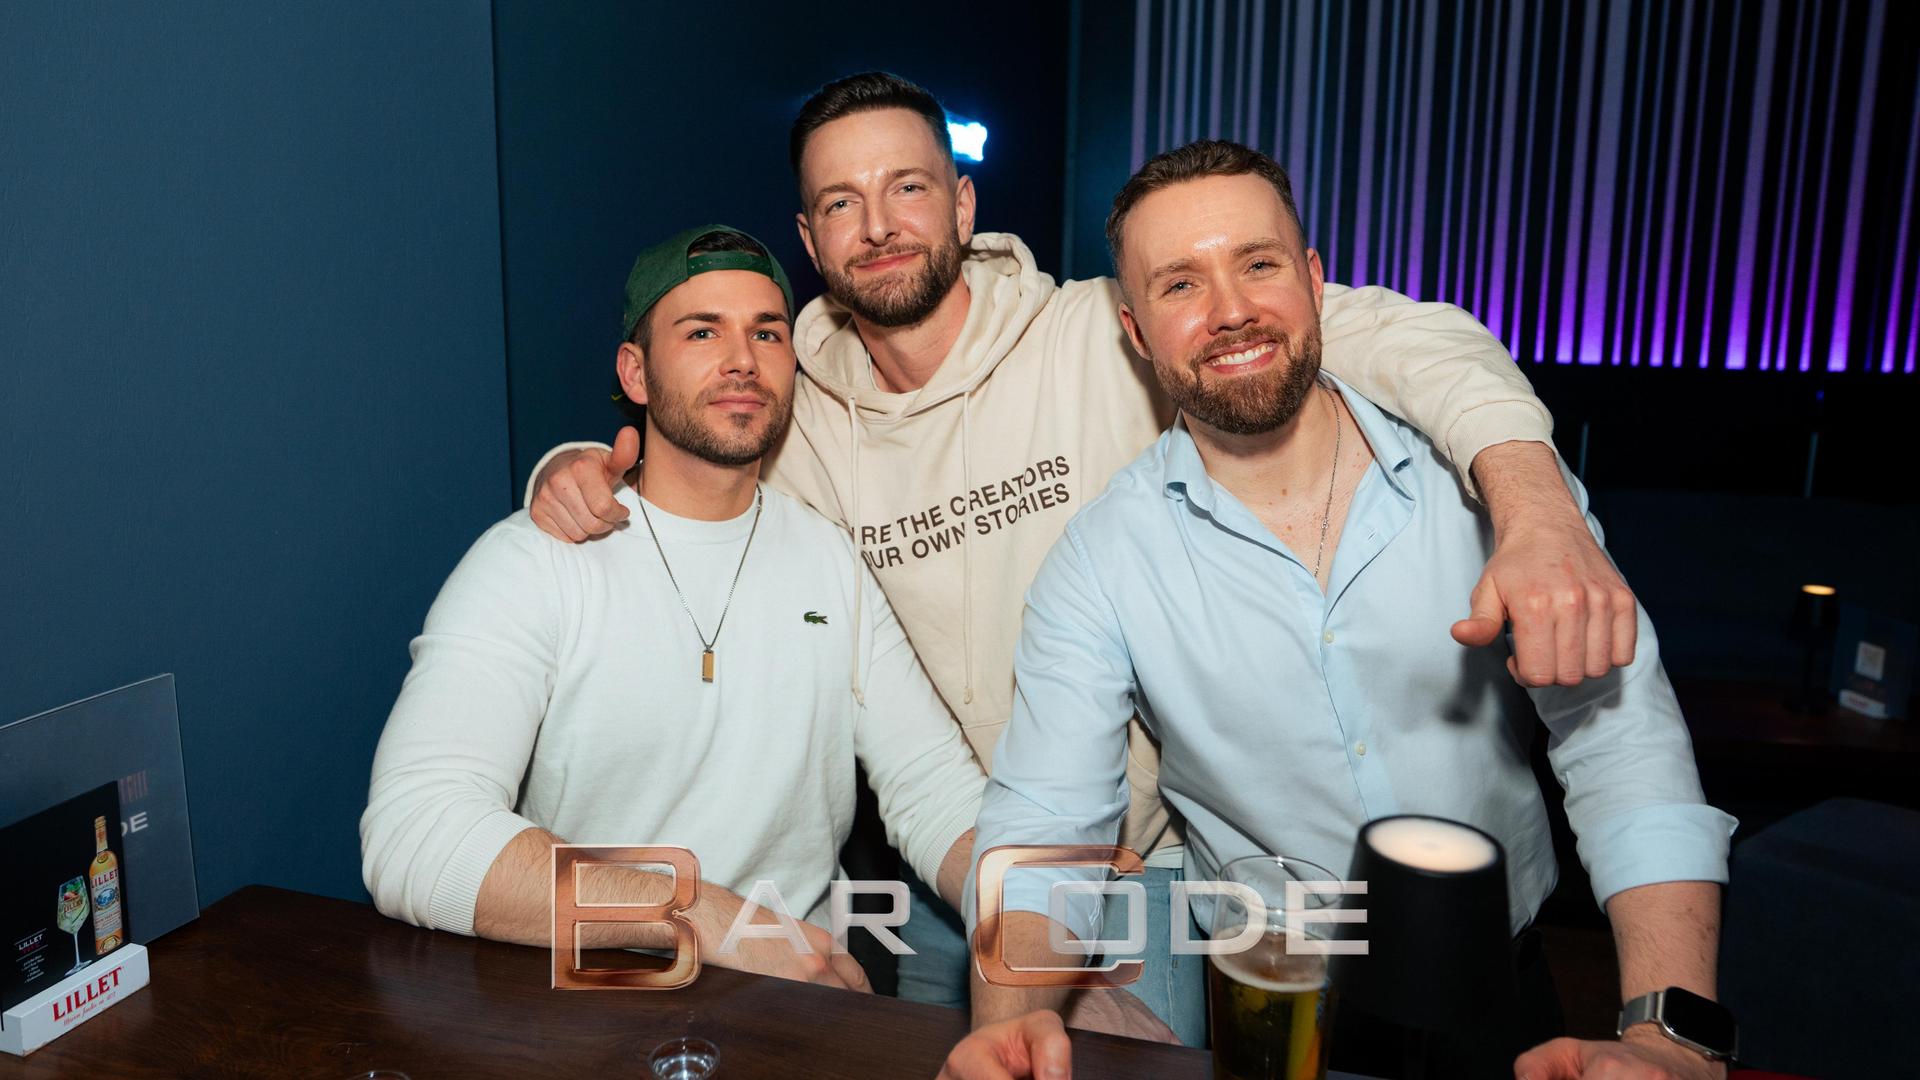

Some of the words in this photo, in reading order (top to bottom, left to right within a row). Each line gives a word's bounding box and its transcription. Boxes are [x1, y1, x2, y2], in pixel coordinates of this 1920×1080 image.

[851, 524, 892, 546] RE
[896, 505, 945, 538] THE
[949, 456, 1071, 516] CREATORS
[911, 522, 966, 559] OWN
[974, 483, 1071, 535] STORIES
[52, 966, 122, 1022] LILLET
